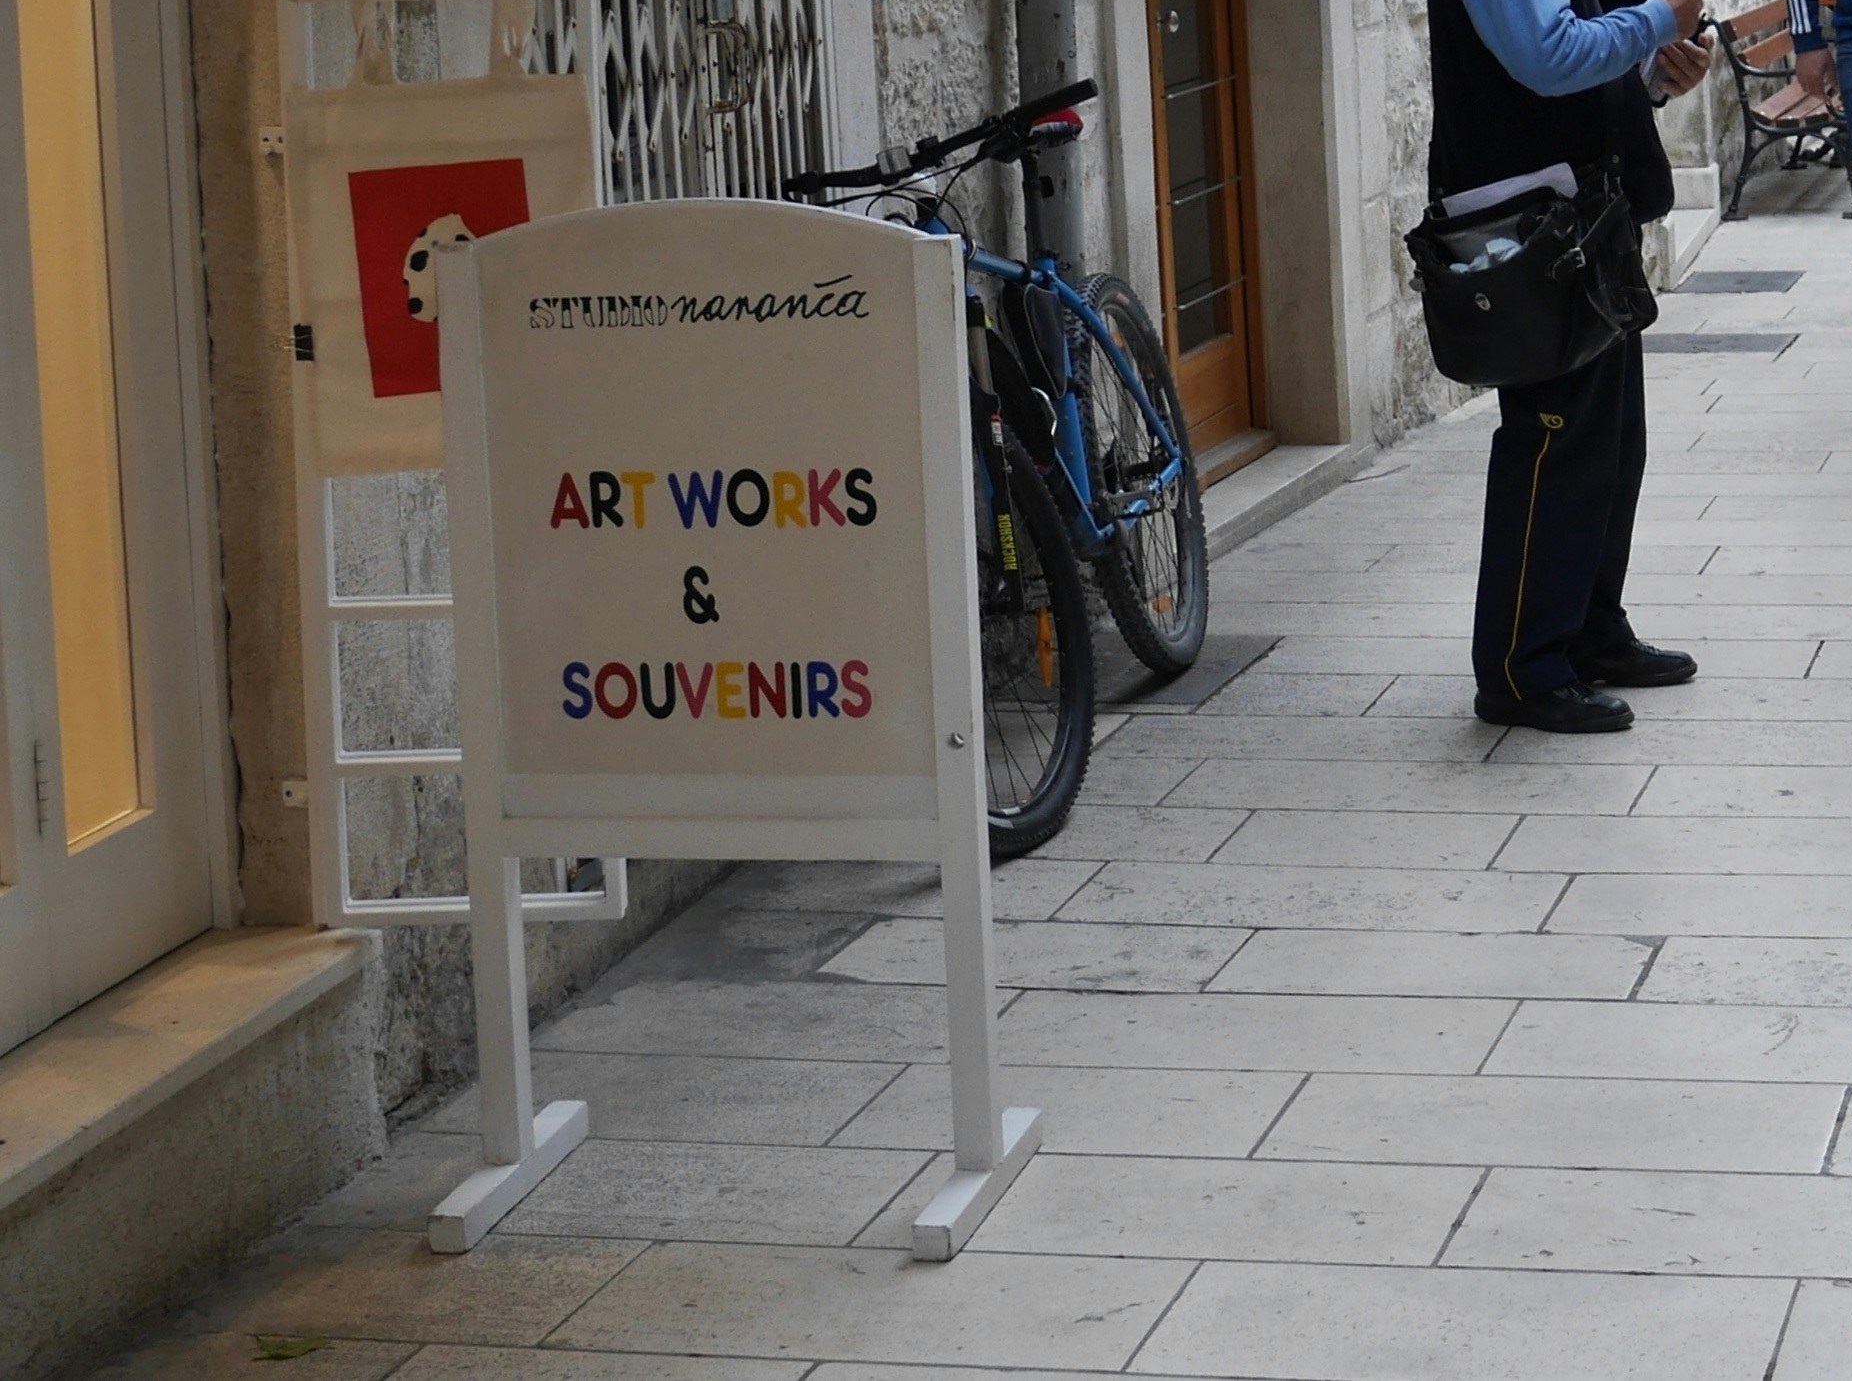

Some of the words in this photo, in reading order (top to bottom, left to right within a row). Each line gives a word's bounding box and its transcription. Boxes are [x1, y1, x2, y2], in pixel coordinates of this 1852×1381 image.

[550, 471, 656, 529] ART
[667, 468, 878, 529] WORKS
[683, 565, 720, 624] &
[562, 659, 872, 719] SOUVENIRS
